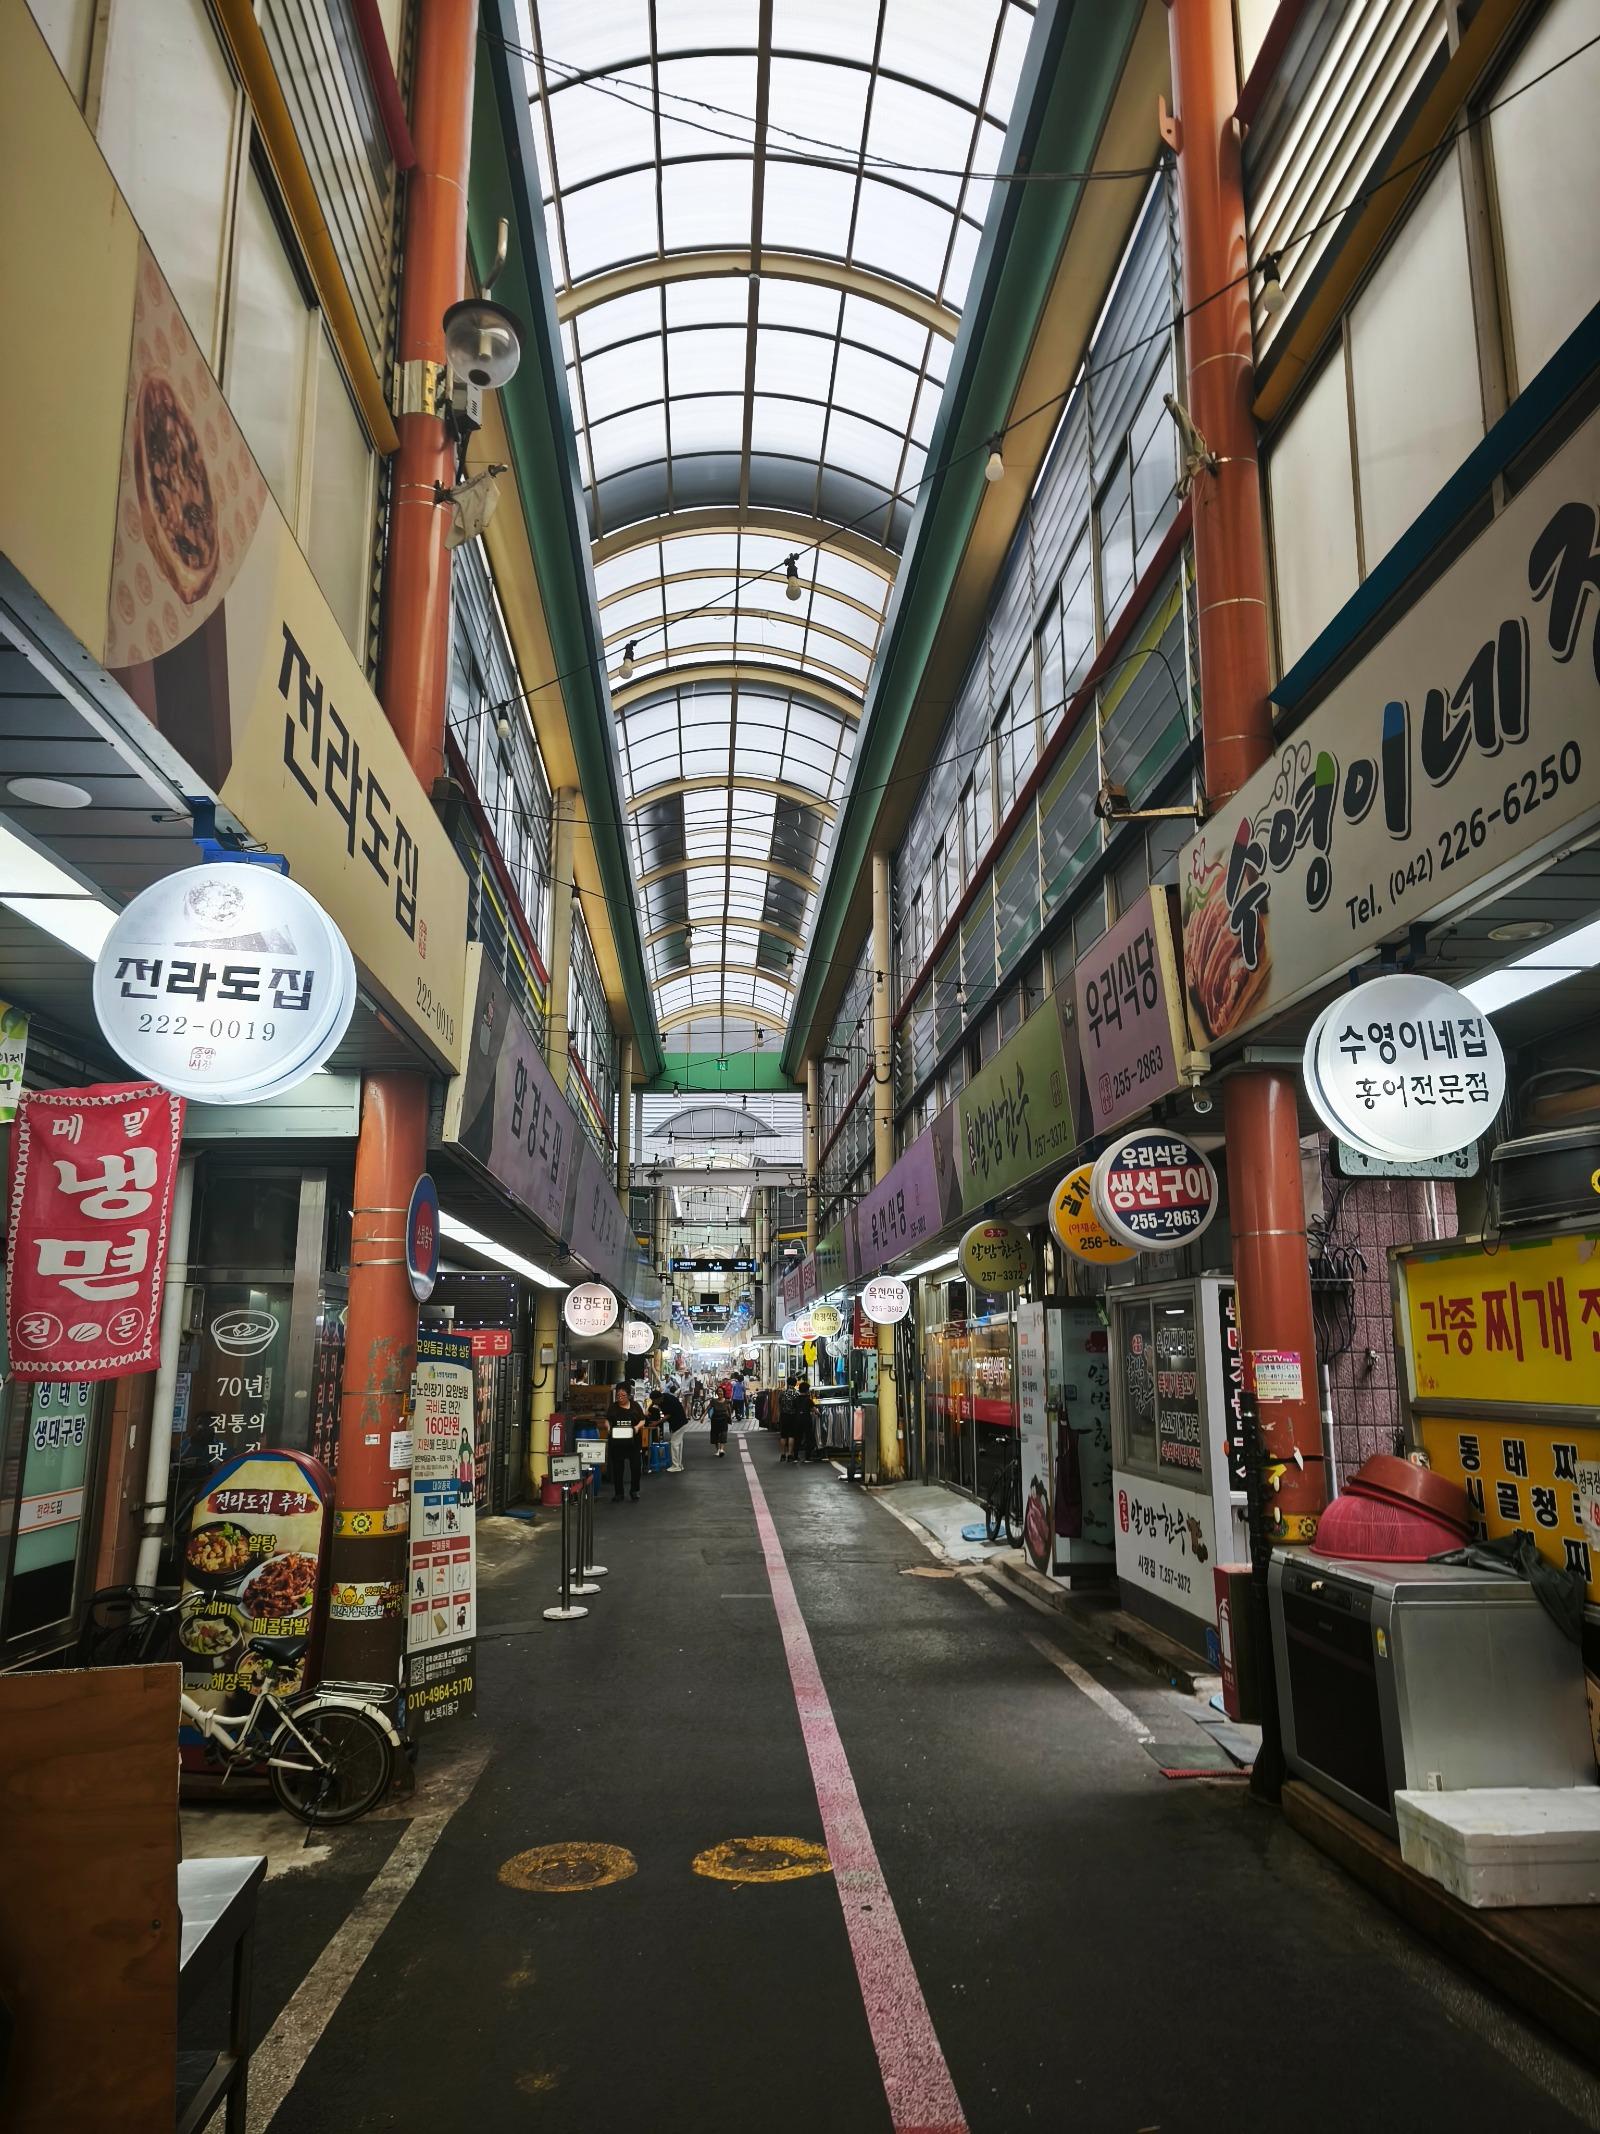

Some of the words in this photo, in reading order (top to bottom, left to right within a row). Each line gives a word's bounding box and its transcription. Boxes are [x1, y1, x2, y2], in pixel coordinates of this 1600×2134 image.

[278, 620, 418, 943] 전라도집
[1346, 894, 1383, 931] Tel.
[1389, 847, 1434, 906] (042)
[1439, 739, 1583, 871] 226-6250
[115, 957, 316, 1011] 전라도집
[1086, 927, 1157, 1048] 우리식당
[416, 976, 454, 1047] 222-0019
[138, 1013, 276, 1042] 222-0019
[1339, 1018, 1488, 1065] 수영이네집
[1113, 1045, 1164, 1100] 255-2863
[1355, 1072, 1490, 1109] 홍어전문점
[510, 1057, 564, 1185] 함경도집
[974, 1061, 1033, 1183] 알밤한우
[1034, 1120, 1068, 1158] 257-3372
[1121, 1144, 1190, 1169] 우리식당
[1109, 1167, 1210, 1208] 생선구이
[871, 1188, 907, 1251] 옥천식당
[1130, 1209, 1201, 1231] 255-2863
[971, 1240, 1023, 1262] 알밤한우
[981, 1270, 1023, 1282] 257-3372
[572, 1296, 612, 1311] 함경도집
[868, 1286, 904, 1300] 옥천식당
[1262, 1355, 1283, 1363] CCTV
[217, 1374, 263, 1398] 70년
[417, 1382, 444, 1398] 노인장기
[33, 1416, 86, 1449] 생대구탕
[208, 1413, 266, 1434] 전통의
[425, 1416, 460, 1436] 160만원
[216, 1491, 274, 1512] 전라도집
[279, 1492, 308, 1512] 추천
[1131, 1498, 1187, 1555] 알밤한우
[248, 1534, 277, 1554] 알탕
[1138, 1555, 1156, 1578] 시장집
[252, 1618, 309, 1636] 매콤닭발
[408, 1676, 473, 1711] 010-4964-5170
